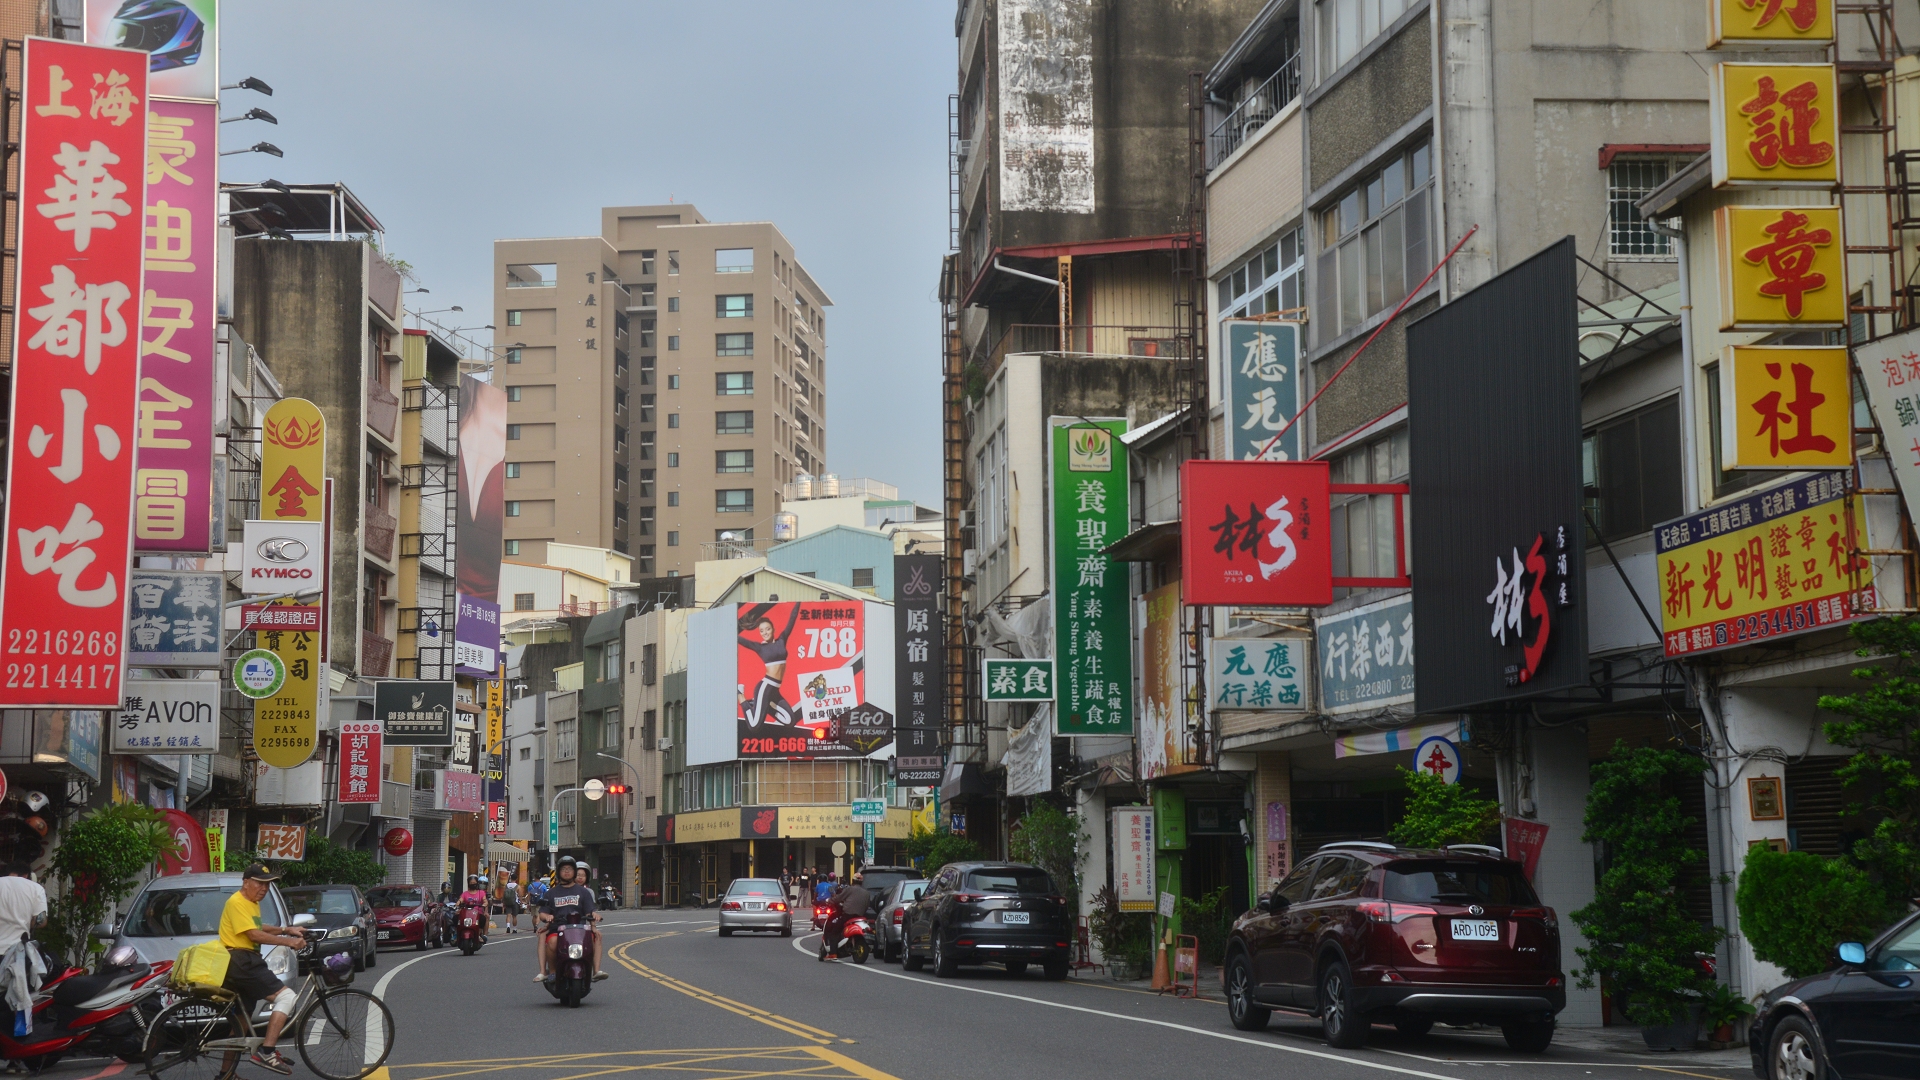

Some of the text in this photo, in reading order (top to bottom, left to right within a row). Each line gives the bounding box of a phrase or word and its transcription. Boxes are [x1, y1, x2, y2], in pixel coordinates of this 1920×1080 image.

[35, 65, 139, 126] 上海
[17, 140, 132, 608] 華都小吃
[1894, 393, 1920, 428] 鍋
[267, 464, 320, 518] 金
[251, 567, 313, 580] KYMCO
[244, 610, 317, 625] 重機認證店
[799, 608, 856, 621] 全新樹林店
[8, 627, 118, 657] 2216268
[906, 608, 930, 663] 原宿
[1069, 590, 1080, 712] Yang Sheng Vegetable
[6, 661, 116, 690] 2214417
[990, 665, 1049, 695] 素食
[118, 696, 147, 730] 雅芳
[261, 710, 310, 720] 2229843
[274, 697, 299, 706] TEL
[813, 697, 844, 709] GYM
[911, 671, 926, 746] 髮型設計
[1108, 682, 1122, 724] 民權店
[273, 725, 298, 734] FAX
[848, 710, 885, 727] EGO
[260, 738, 310, 748] 2295698
[741, 737, 806, 754] 2210-666
[348, 734, 369, 794] 胡記麵館
[899, 771, 941, 780] 06-2222825
[1130, 814, 1142, 852] 養聖齋
[1453, 923, 1498, 938] ARD-1095
